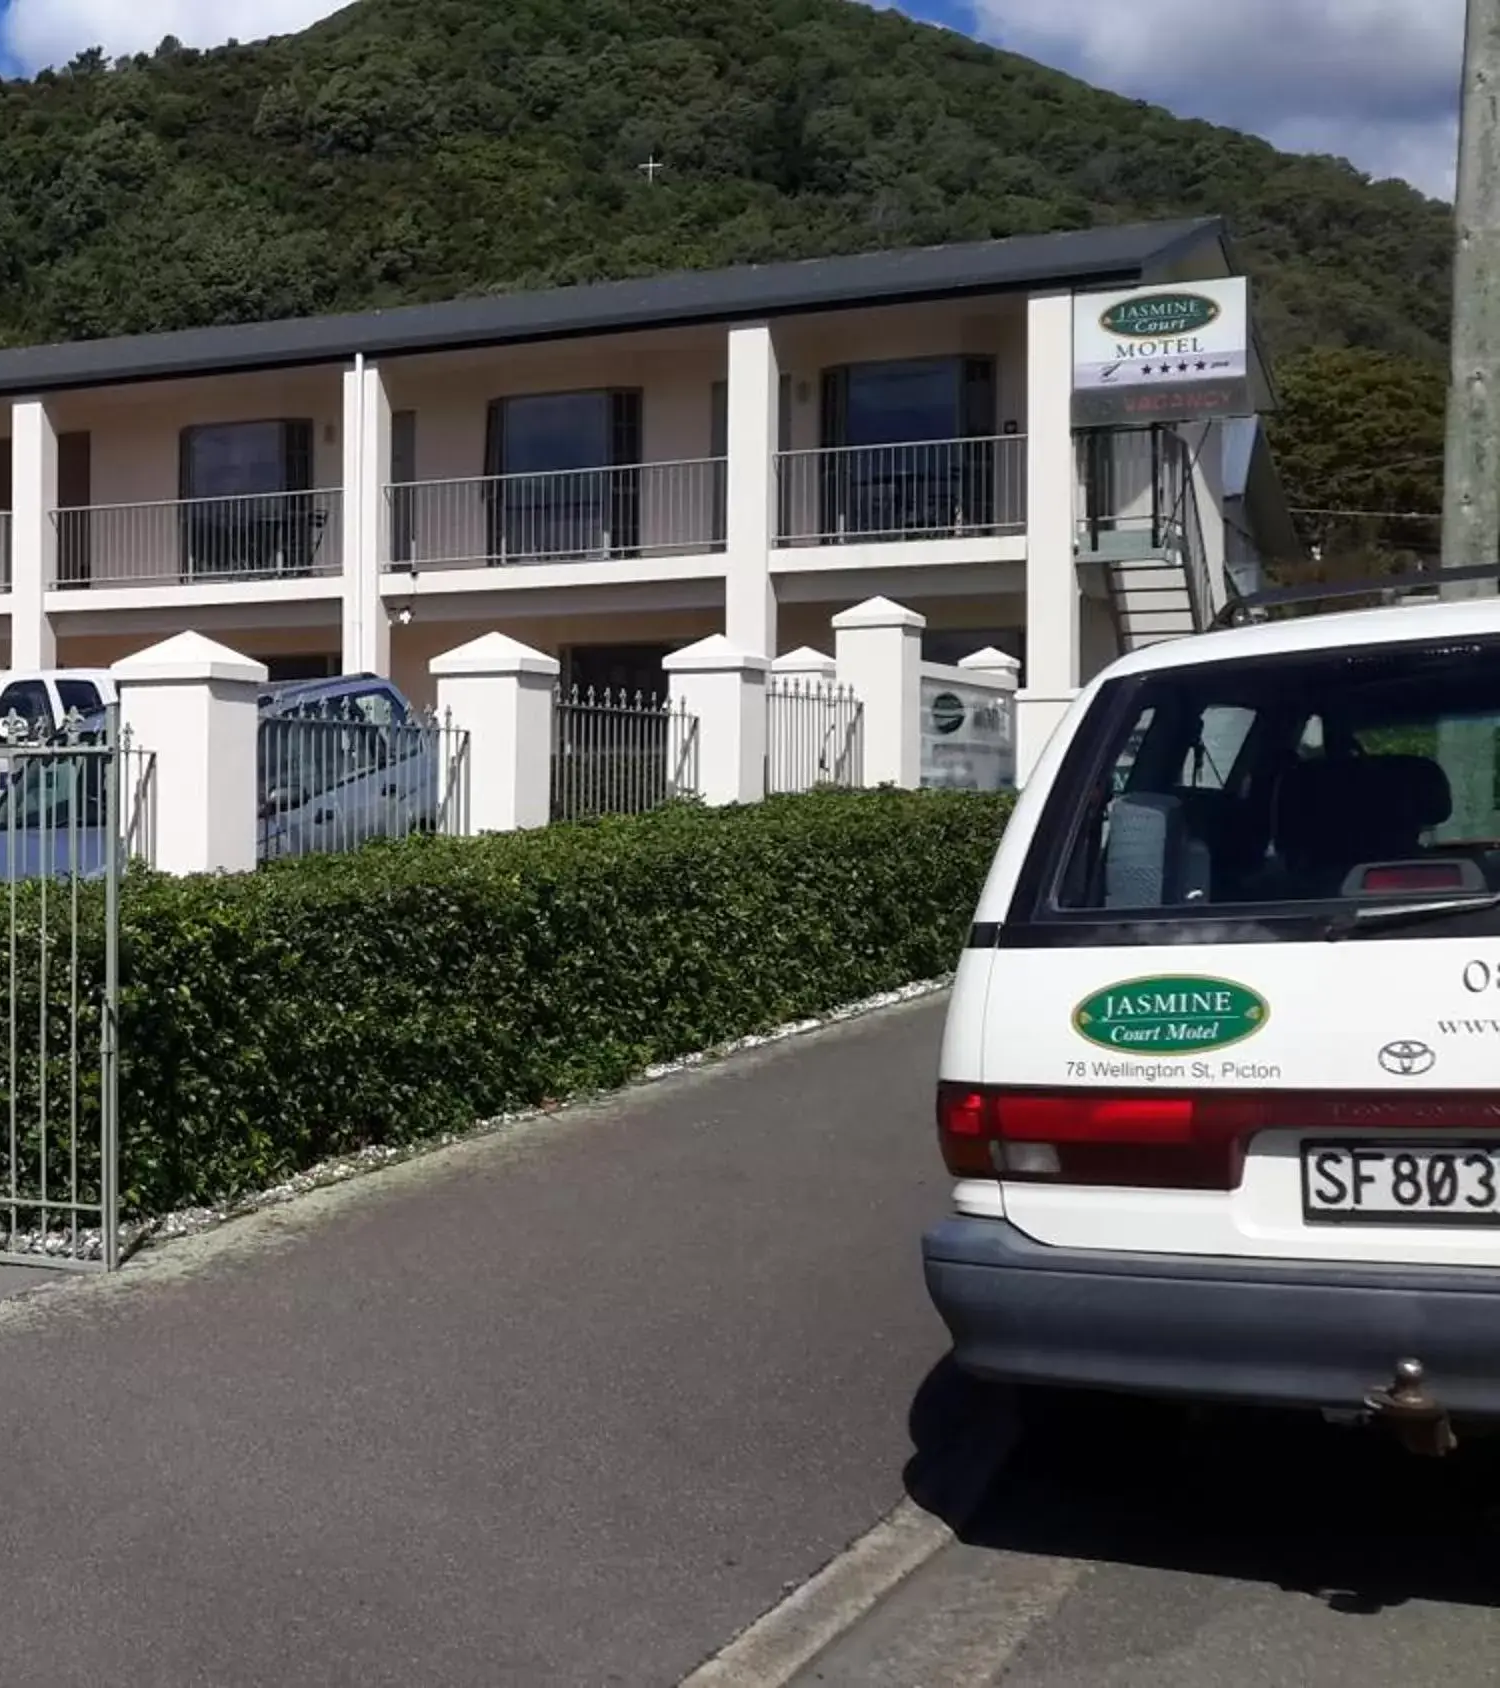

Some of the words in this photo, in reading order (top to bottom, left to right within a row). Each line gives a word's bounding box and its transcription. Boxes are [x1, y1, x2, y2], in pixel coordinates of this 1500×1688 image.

[1119, 299, 1200, 320] JASMINE
[1134, 319, 1186, 333] Court
[1115, 338, 1205, 359] MOTEL
[1126, 389, 1232, 412] VACANCY
[1105, 991, 1233, 1019] JASMINE
[1111, 1025, 1160, 1042] Court
[1166, 1022, 1219, 1041] Motel
[1066, 1061, 1086, 1077] 78
[1092, 1062, 1185, 1081] Wellington
[1191, 1063, 1215, 1079] St,
[1221, 1062, 1281, 1079] Picton
